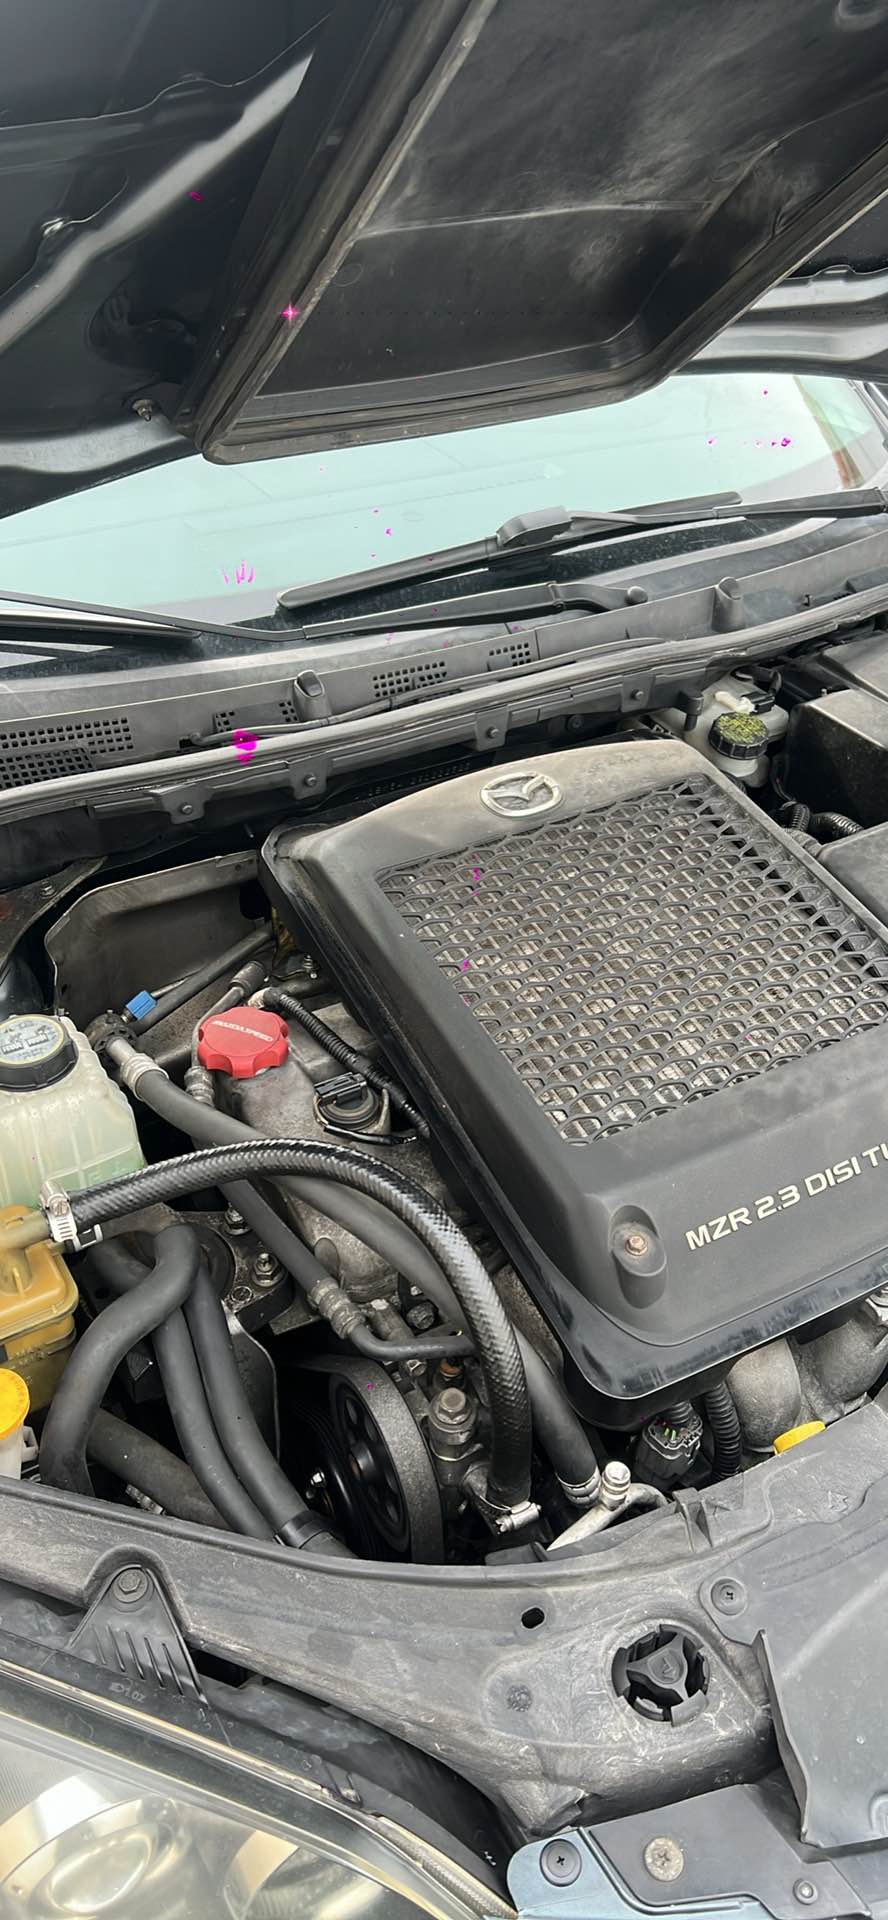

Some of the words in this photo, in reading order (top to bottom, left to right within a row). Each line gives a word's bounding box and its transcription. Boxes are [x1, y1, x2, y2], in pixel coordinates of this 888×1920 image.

[685, 1207, 752, 1250] MZR
[754, 1185, 801, 1220] 2.3
[804, 1156, 862, 1196] DISI
